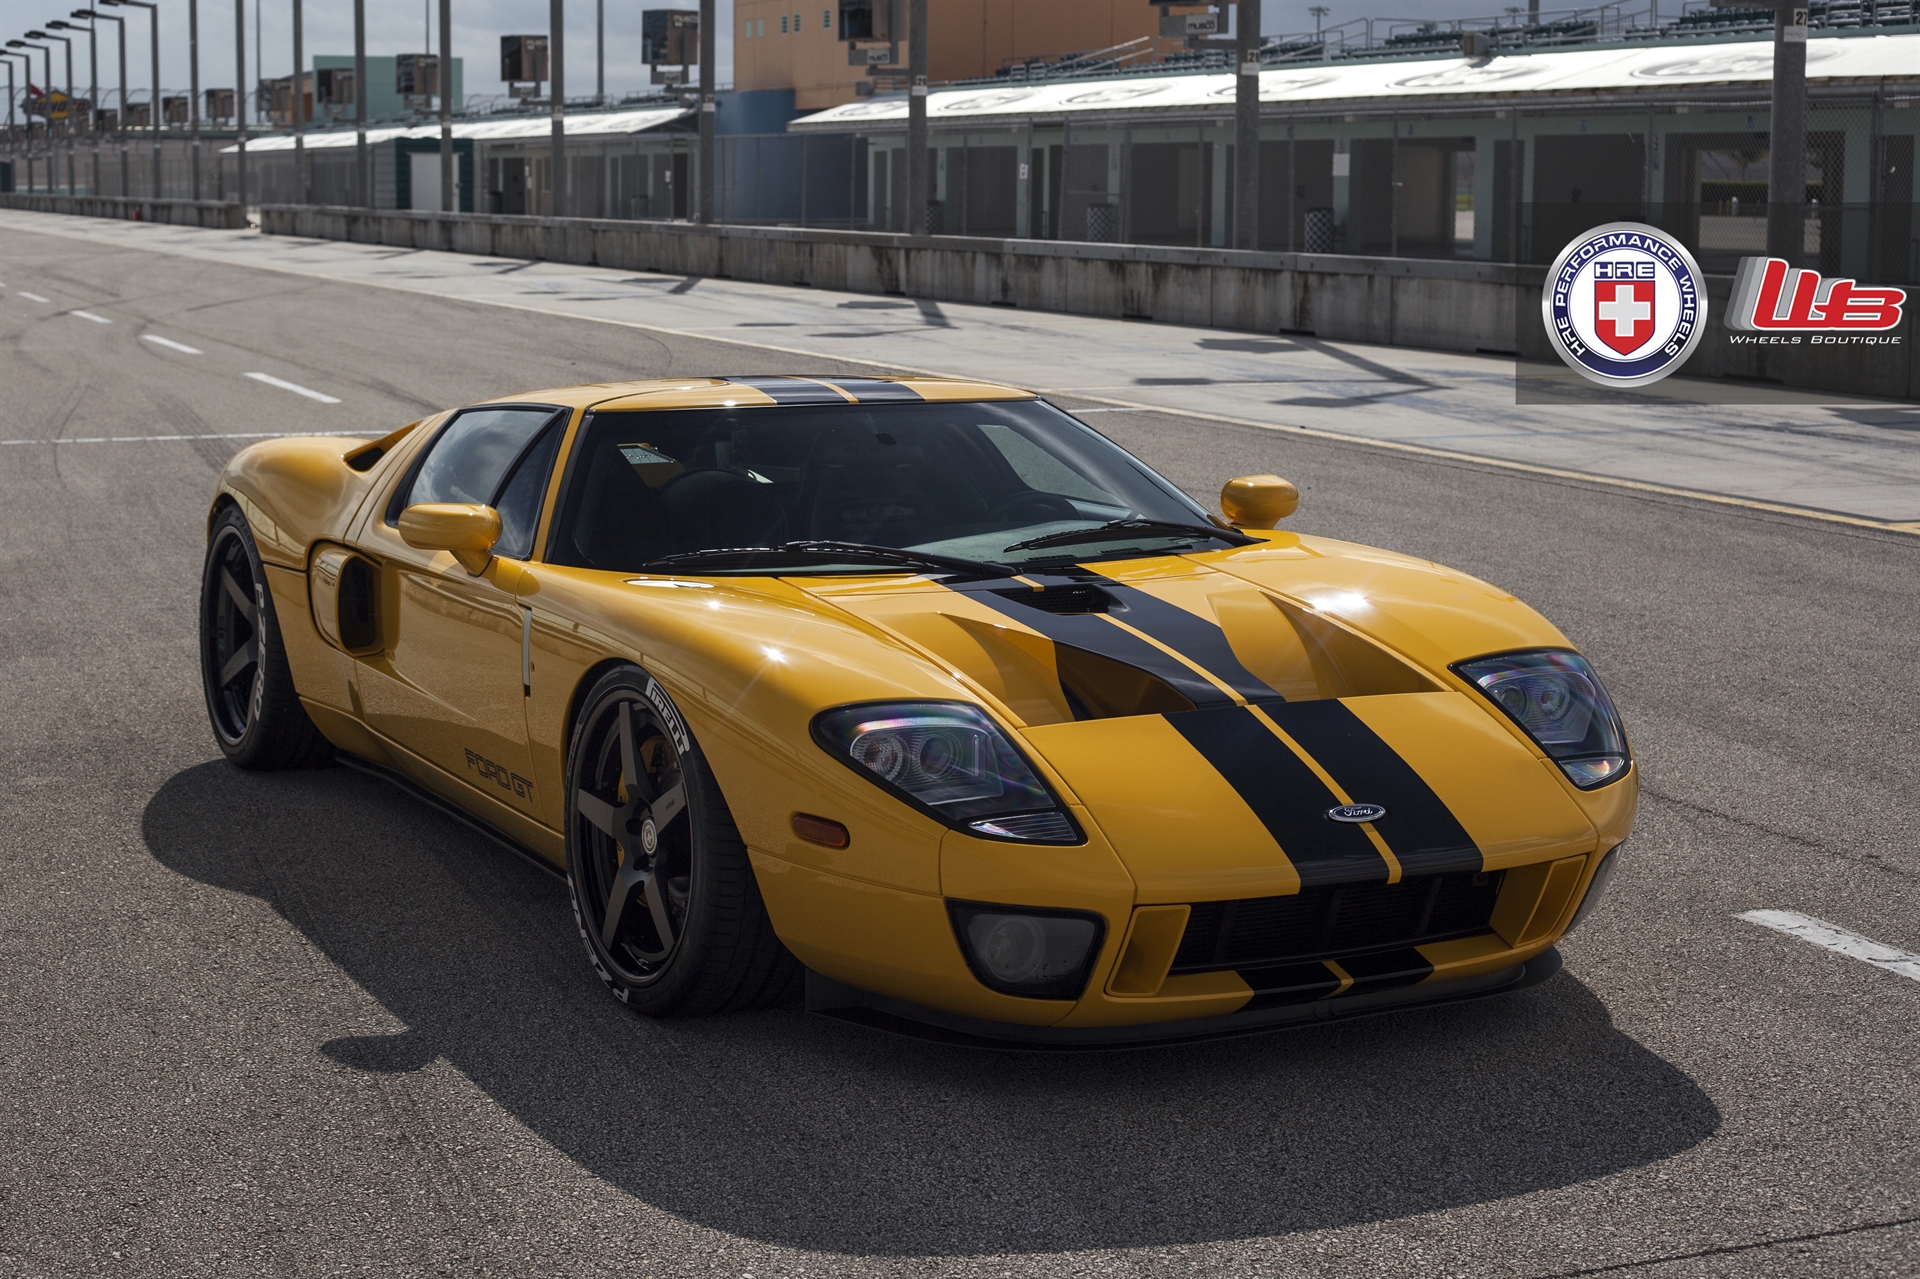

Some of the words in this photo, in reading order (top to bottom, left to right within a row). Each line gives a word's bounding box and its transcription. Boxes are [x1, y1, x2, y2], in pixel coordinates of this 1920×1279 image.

[1188, 20, 1216, 30] musco
[1796, 12, 1807, 26] 27
[645, 676, 691, 756] PIRELLI
[464, 747, 512, 791] FORD
[510, 772, 534, 803] GT
[1343, 806, 1374, 817] Ford
